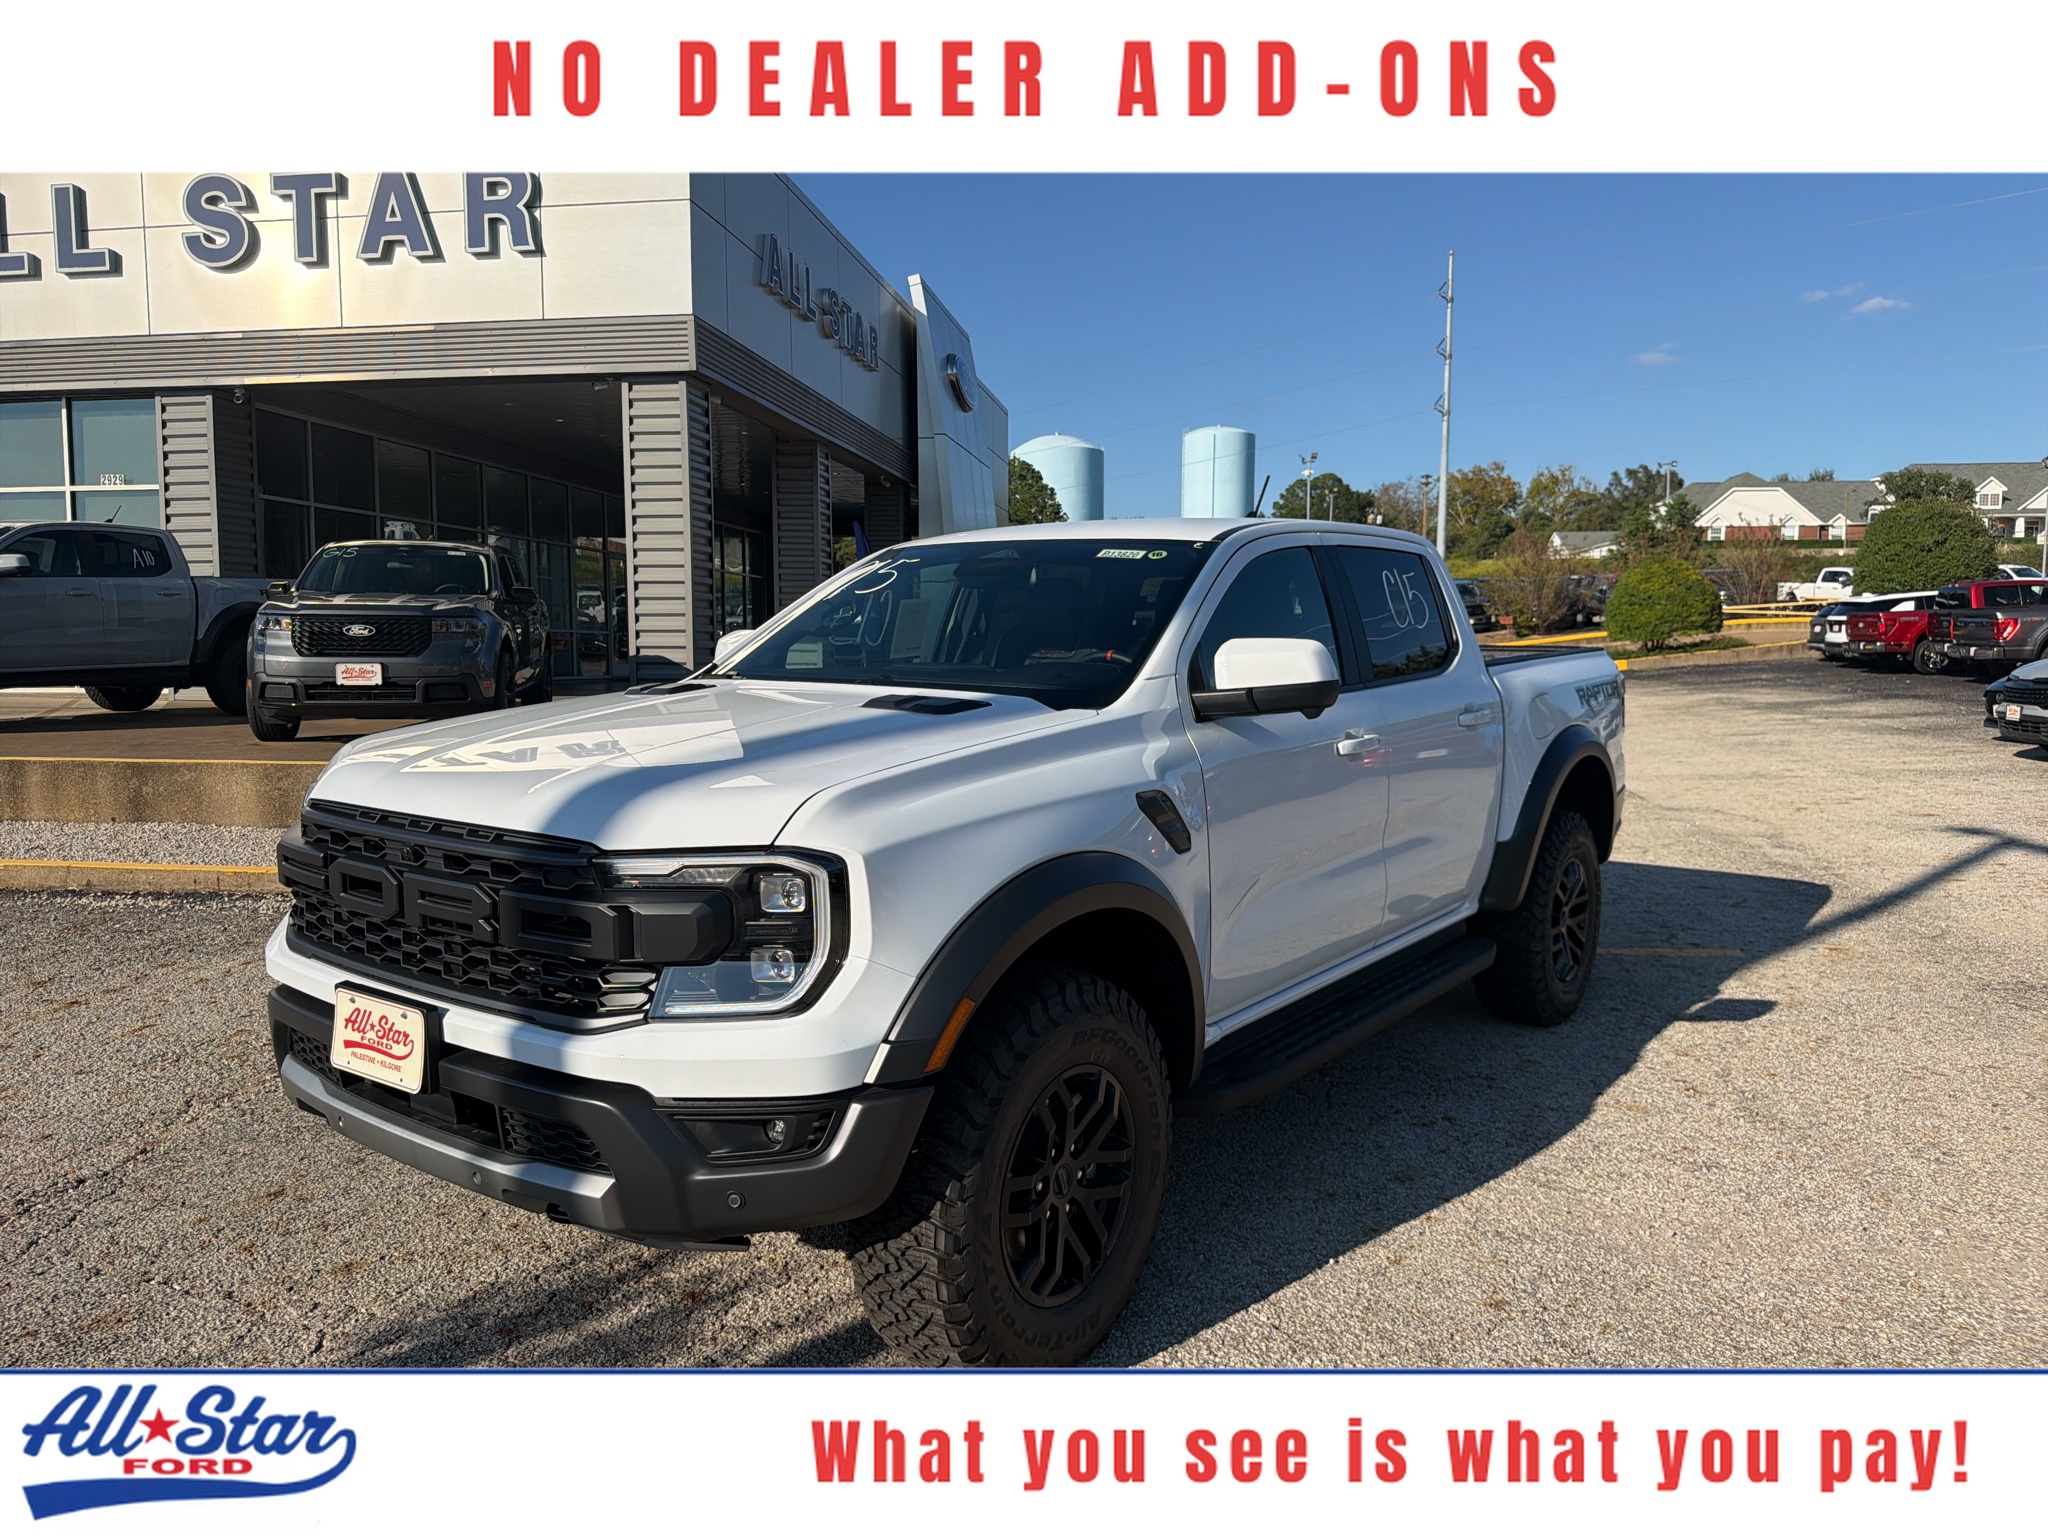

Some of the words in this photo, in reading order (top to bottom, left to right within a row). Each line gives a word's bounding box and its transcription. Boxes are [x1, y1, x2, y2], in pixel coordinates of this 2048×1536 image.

[181, 172, 546, 273] STAR
[757, 233, 818, 322] ALL
[819, 288, 880, 372] STAR
[101, 474, 124, 486] 2929
[132, 548, 156, 569] A10
[1574, 680, 1621, 709] RAPTOR
[277, 836, 618, 961] FORD
[360, 1035, 393, 1051] FORD
[350, 1050, 377, 1065] PALESTINE
[380, 1060, 403, 1073] KILGORE
